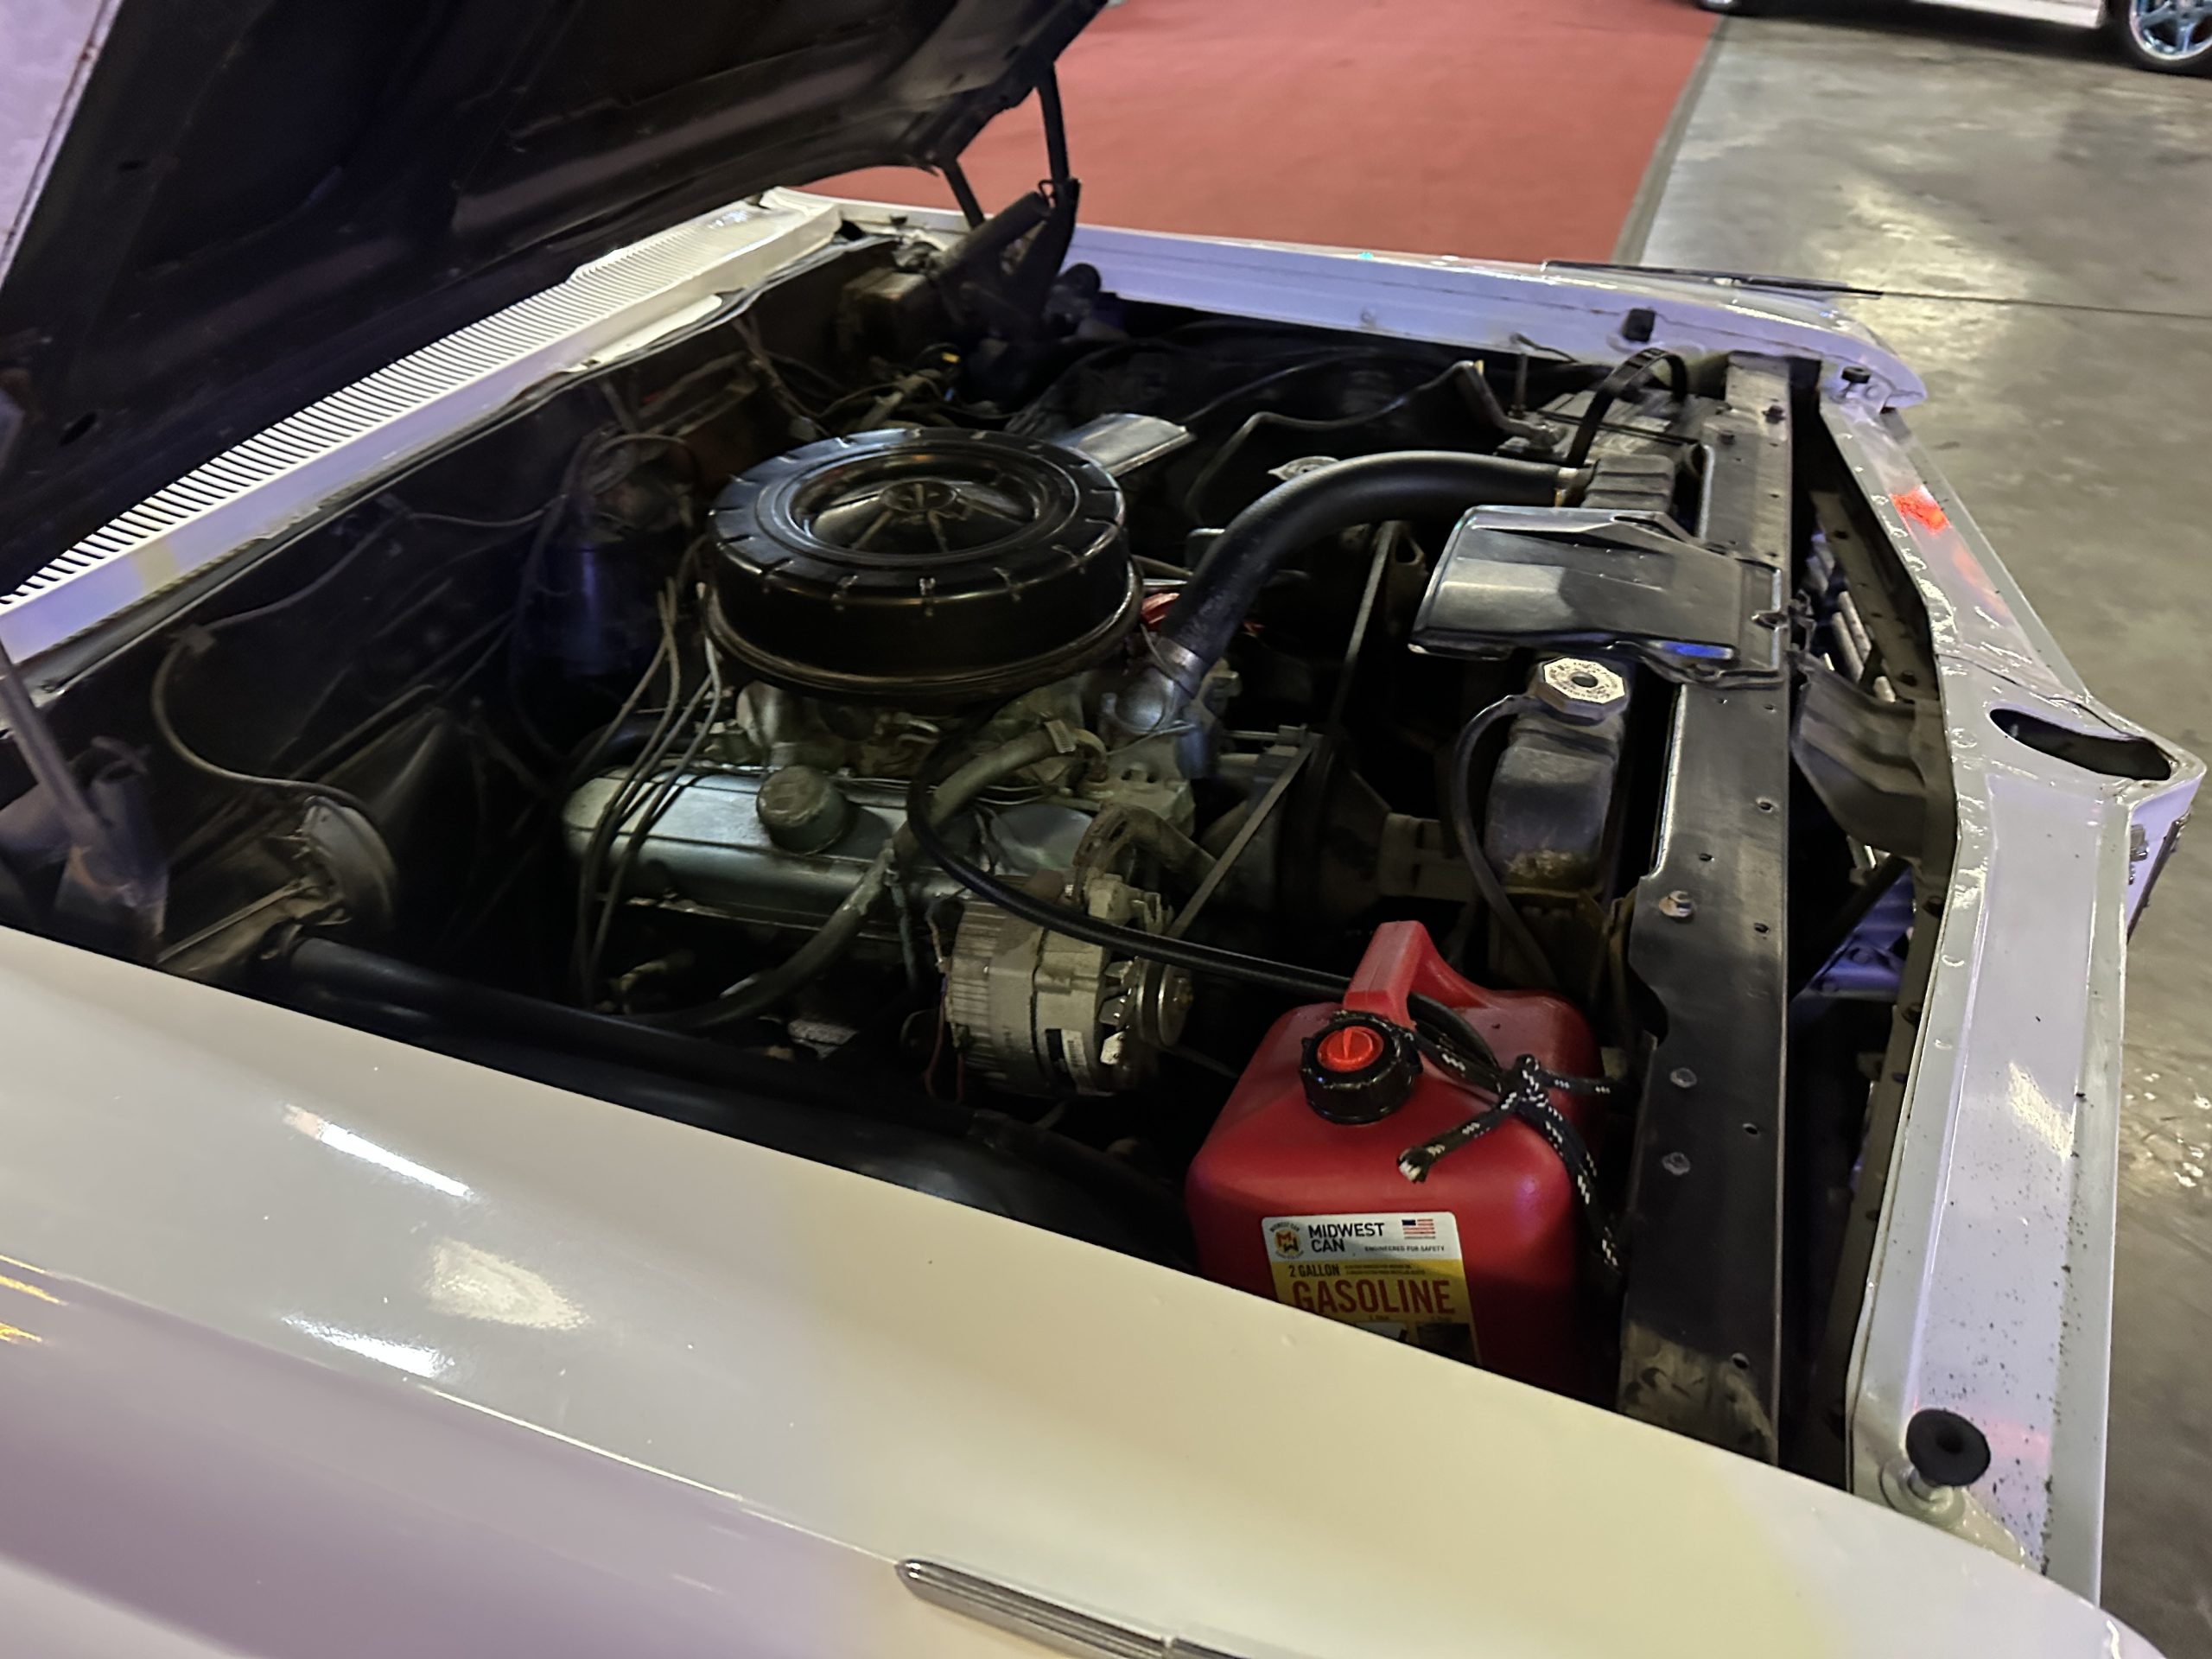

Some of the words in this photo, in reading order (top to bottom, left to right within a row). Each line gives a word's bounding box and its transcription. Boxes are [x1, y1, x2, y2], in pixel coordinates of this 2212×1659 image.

[1308, 1223, 1384, 1238] MIDWEST
[1312, 1238, 1345, 1253] CAN
[1288, 1265, 1295, 1278] 2
[1298, 1264, 1340, 1278] GALLON
[1292, 1279, 1455, 1314] GASOLINE
